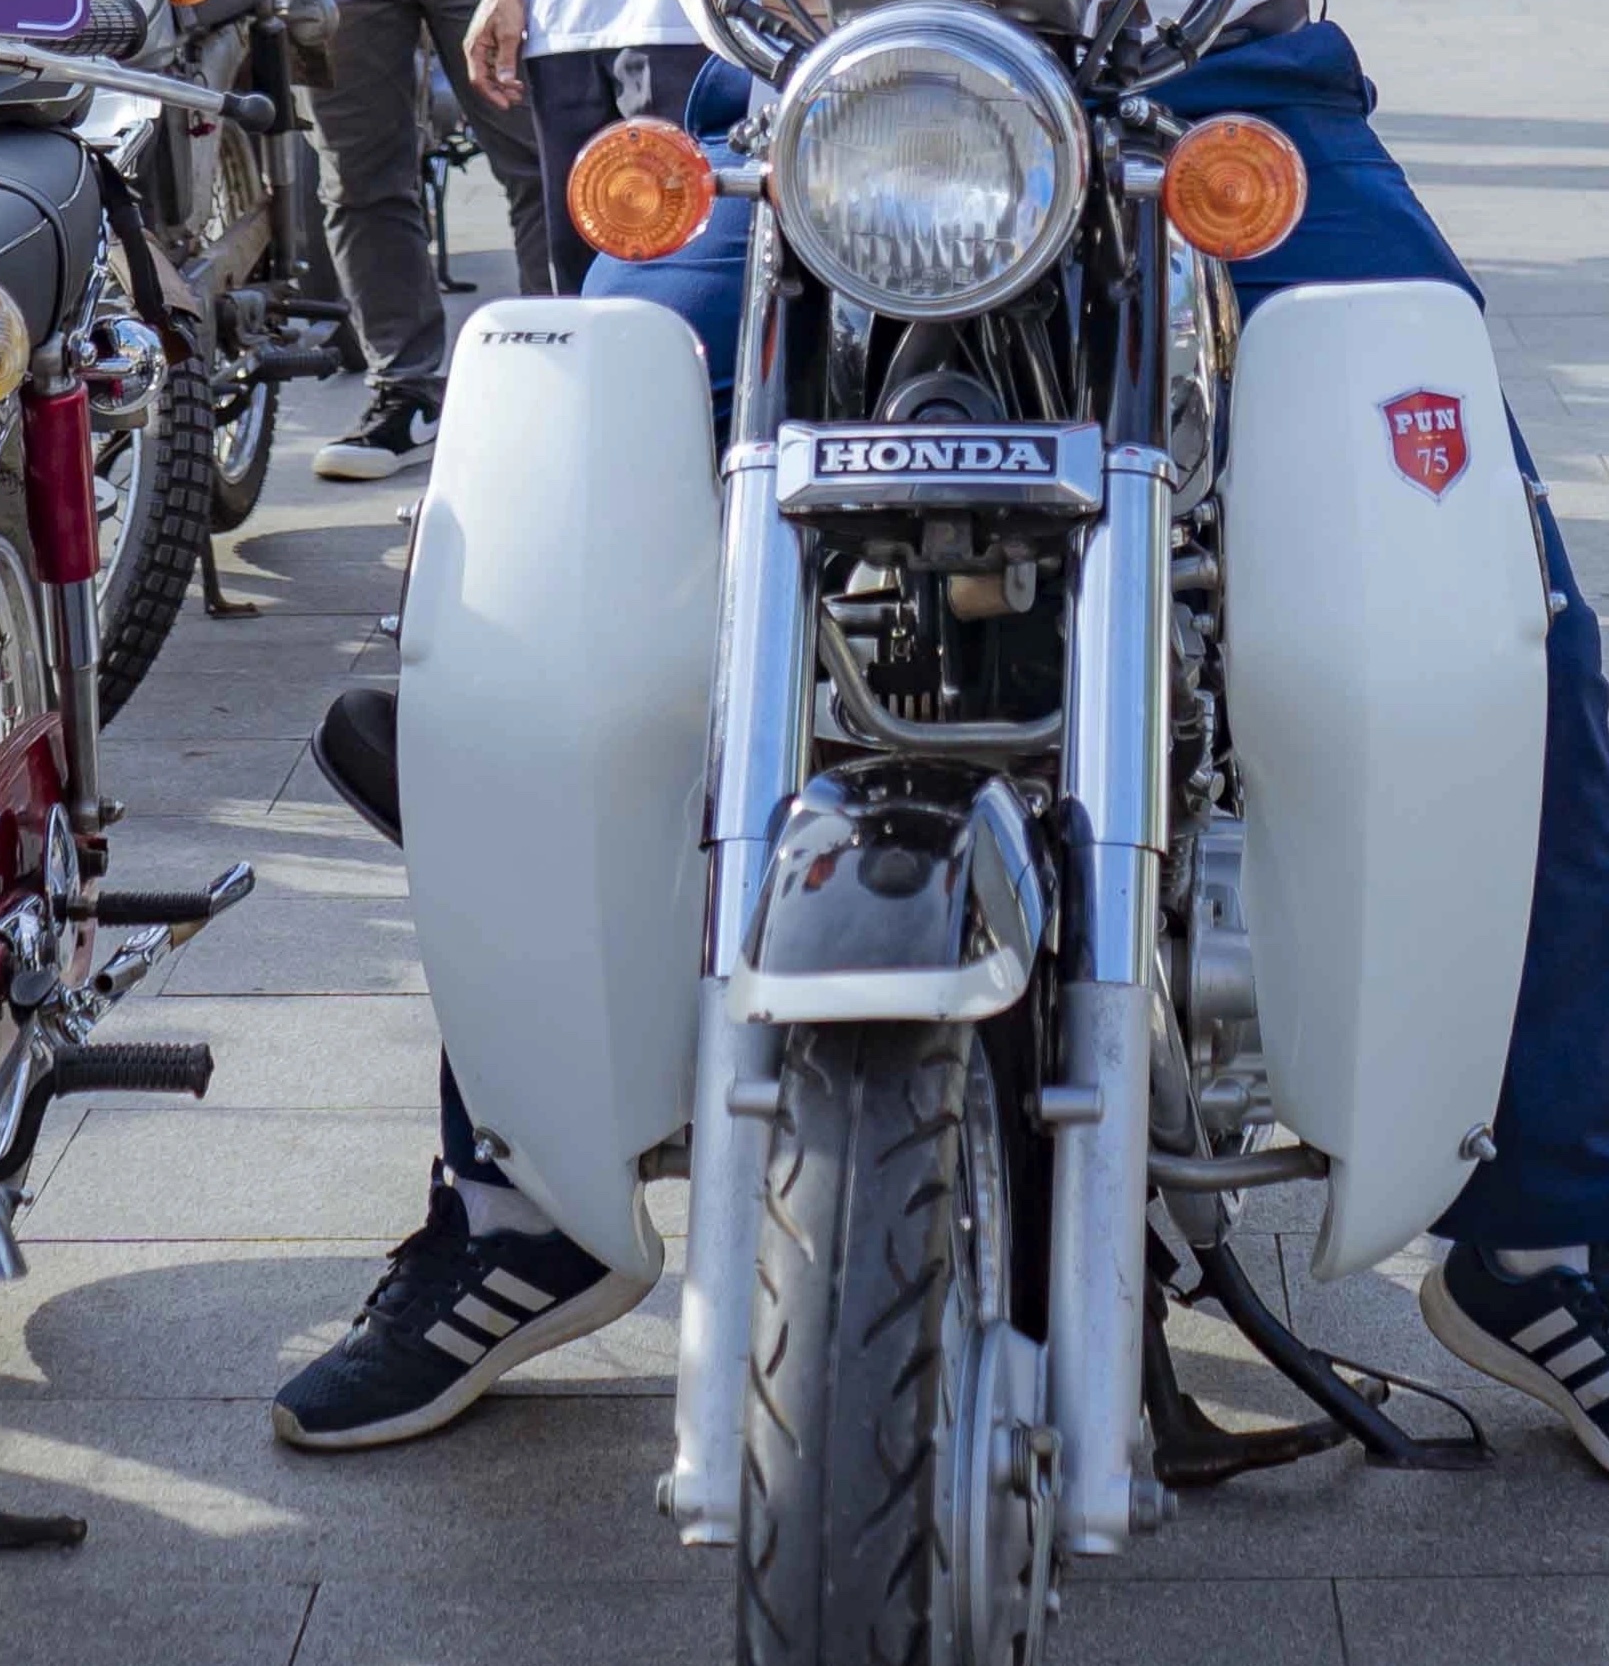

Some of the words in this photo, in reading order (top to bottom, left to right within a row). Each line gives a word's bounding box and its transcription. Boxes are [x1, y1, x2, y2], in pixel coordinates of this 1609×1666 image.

[479, 332, 576, 345] TREK
[1394, 408, 1456, 435] PUN
[820, 438, 1051, 472] HONDA
[1417, 447, 1450, 477] 75
